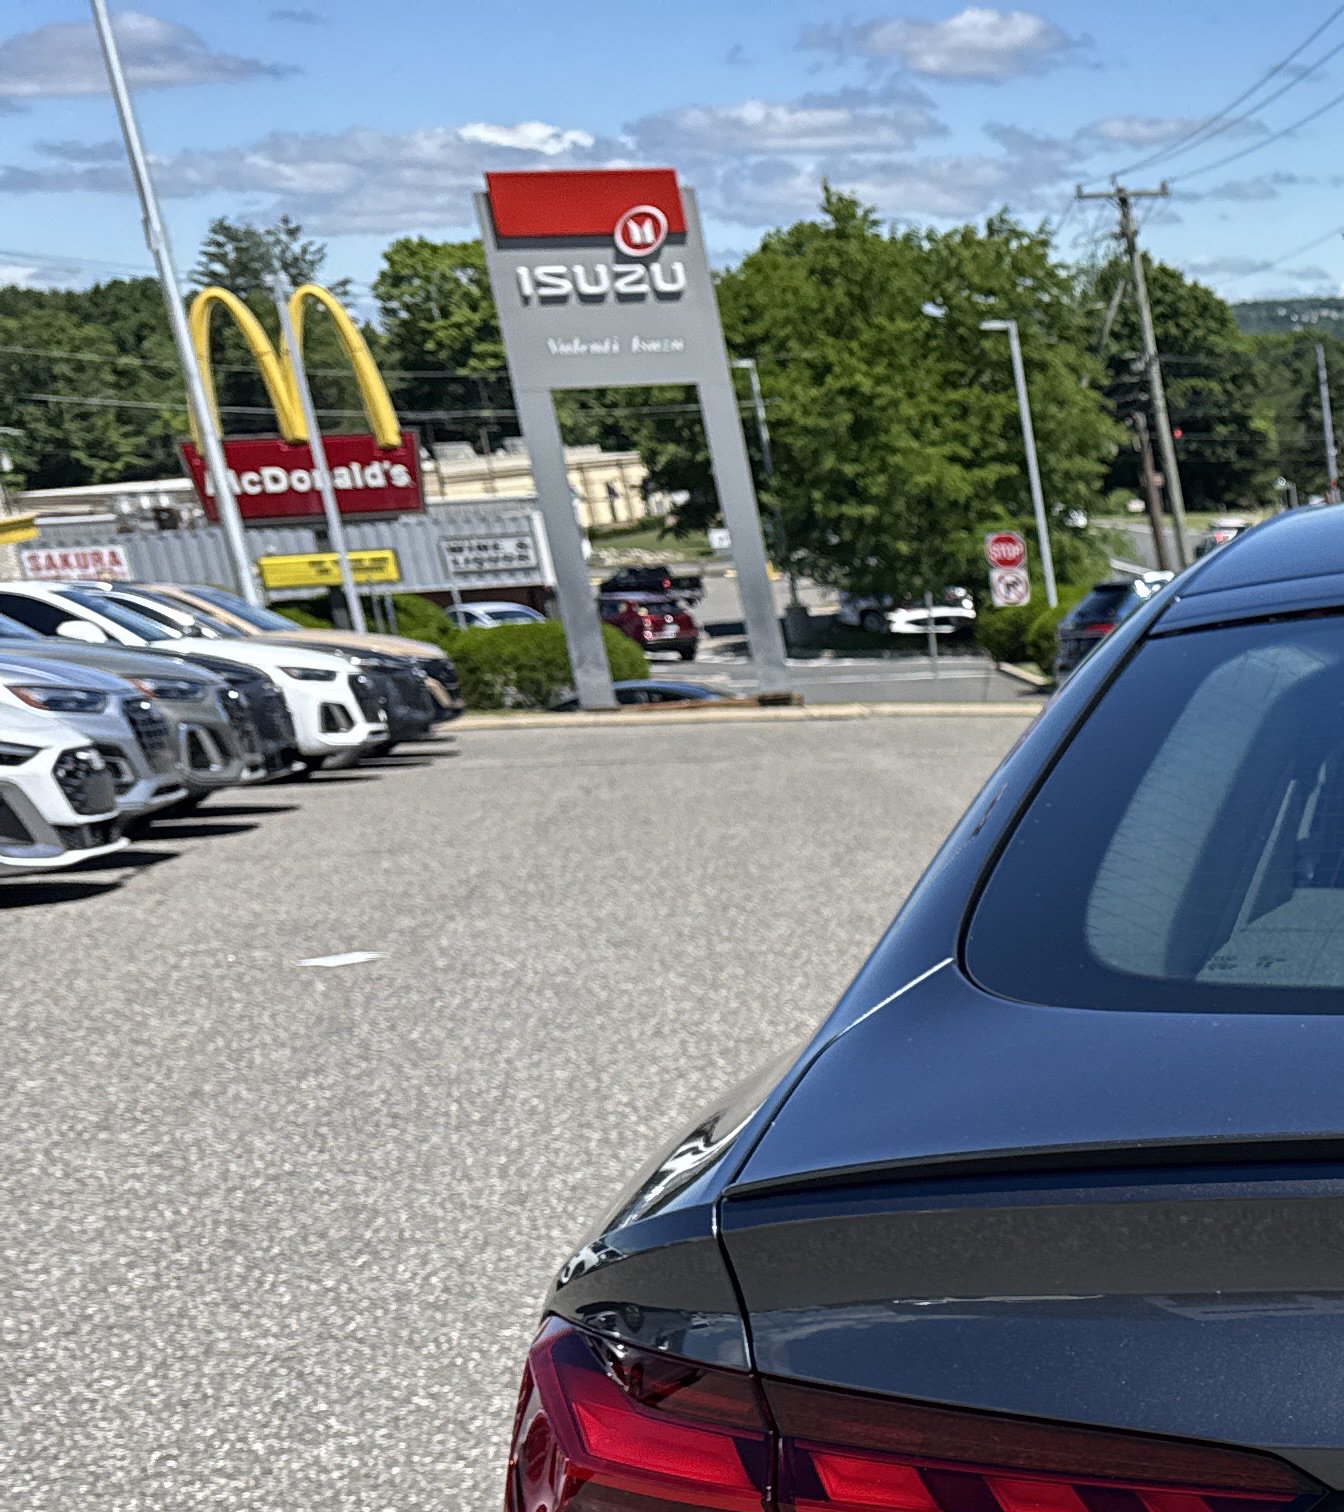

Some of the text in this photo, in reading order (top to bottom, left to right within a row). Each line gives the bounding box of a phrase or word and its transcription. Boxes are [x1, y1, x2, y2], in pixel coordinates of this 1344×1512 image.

[516, 262, 687, 299] ISUZU
[27, 551, 122, 572] SAKURA
[988, 544, 1024, 558] STOP
